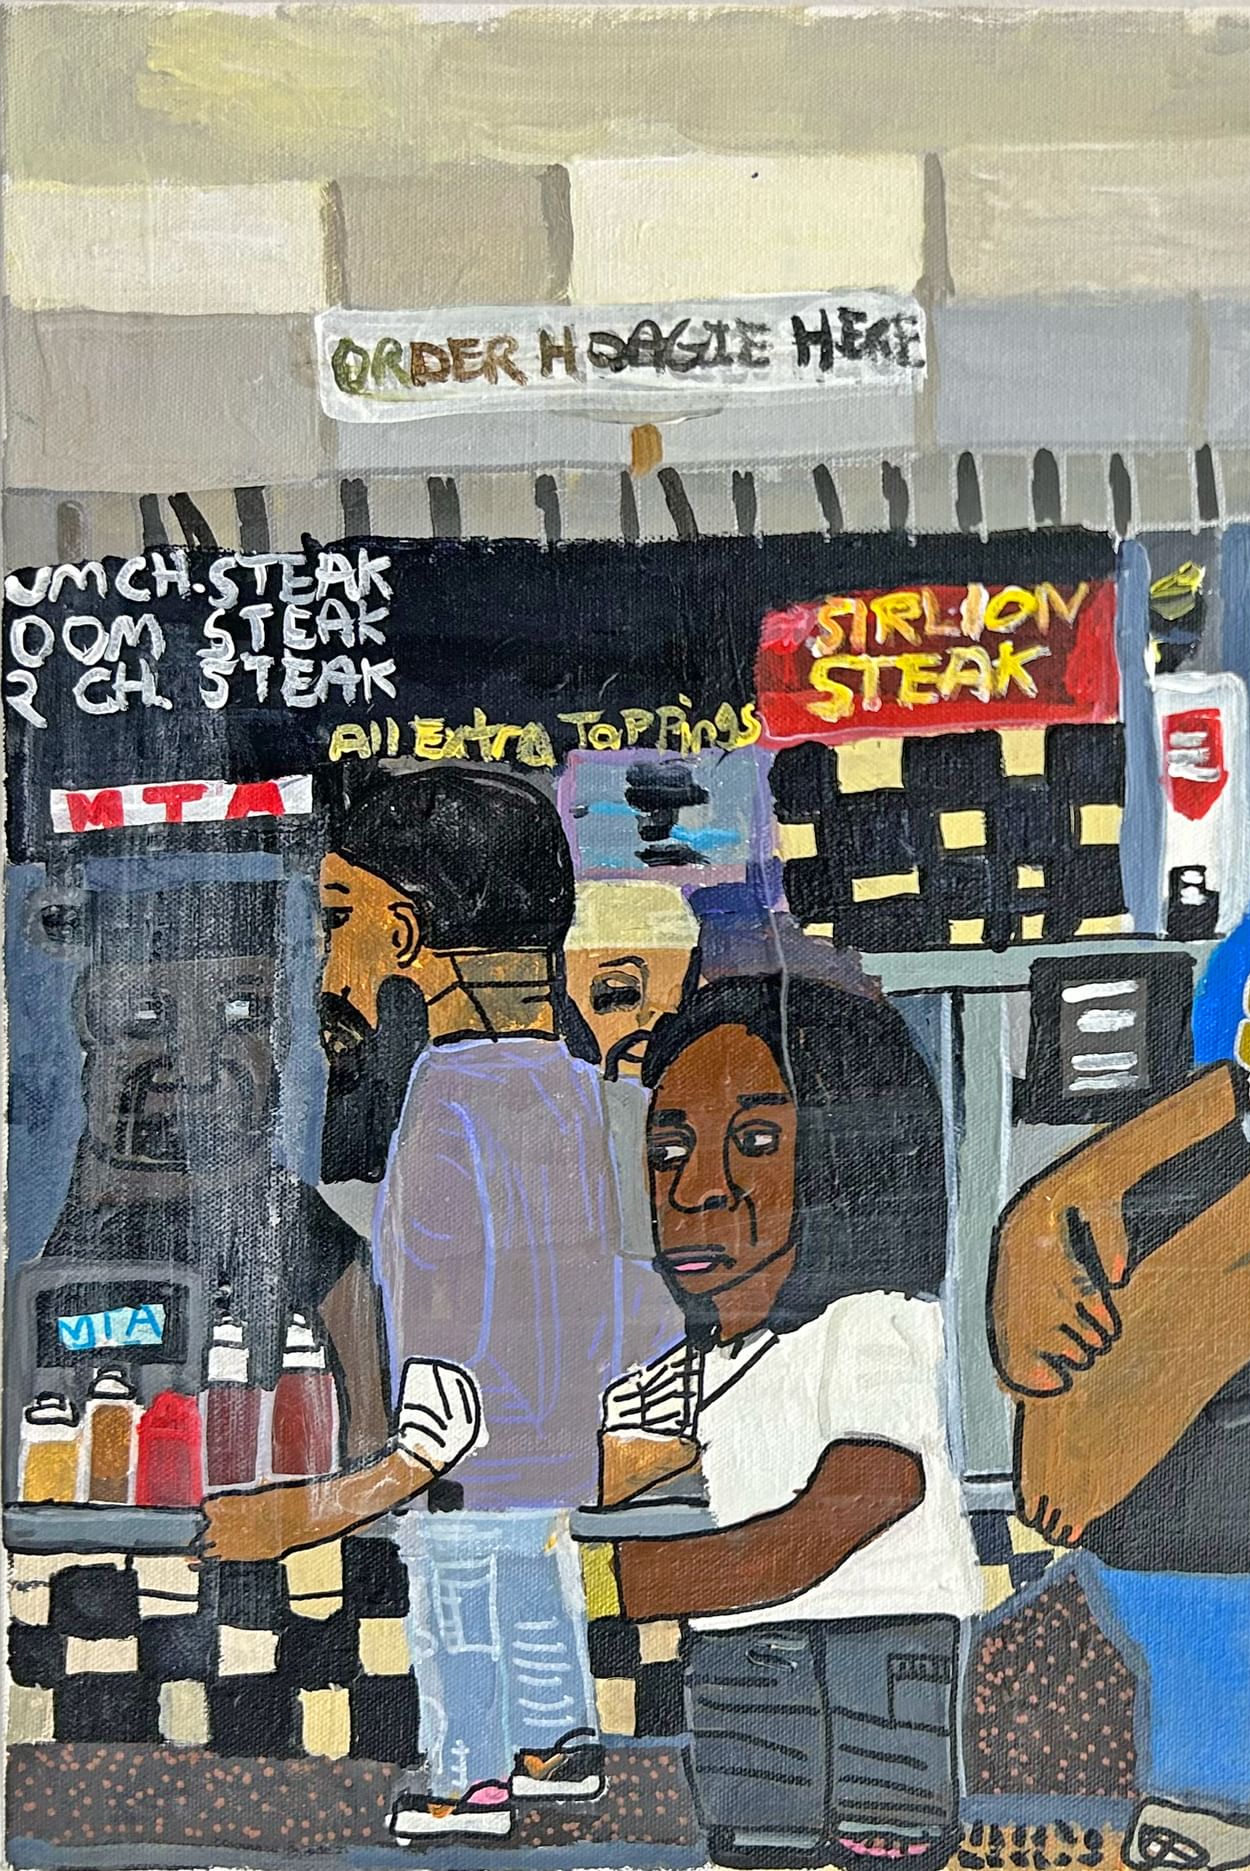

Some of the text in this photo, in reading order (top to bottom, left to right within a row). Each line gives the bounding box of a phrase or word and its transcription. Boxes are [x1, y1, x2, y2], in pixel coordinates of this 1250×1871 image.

[208, 548, 394, 608] STEAK
[197, 598, 391, 662] STEAK
[804, 582, 1088, 657] SIRLION
[199, 648, 398, 709] STEAK
[806, 640, 1052, 723] STEAK
[65, 781, 286, 833] MTA
